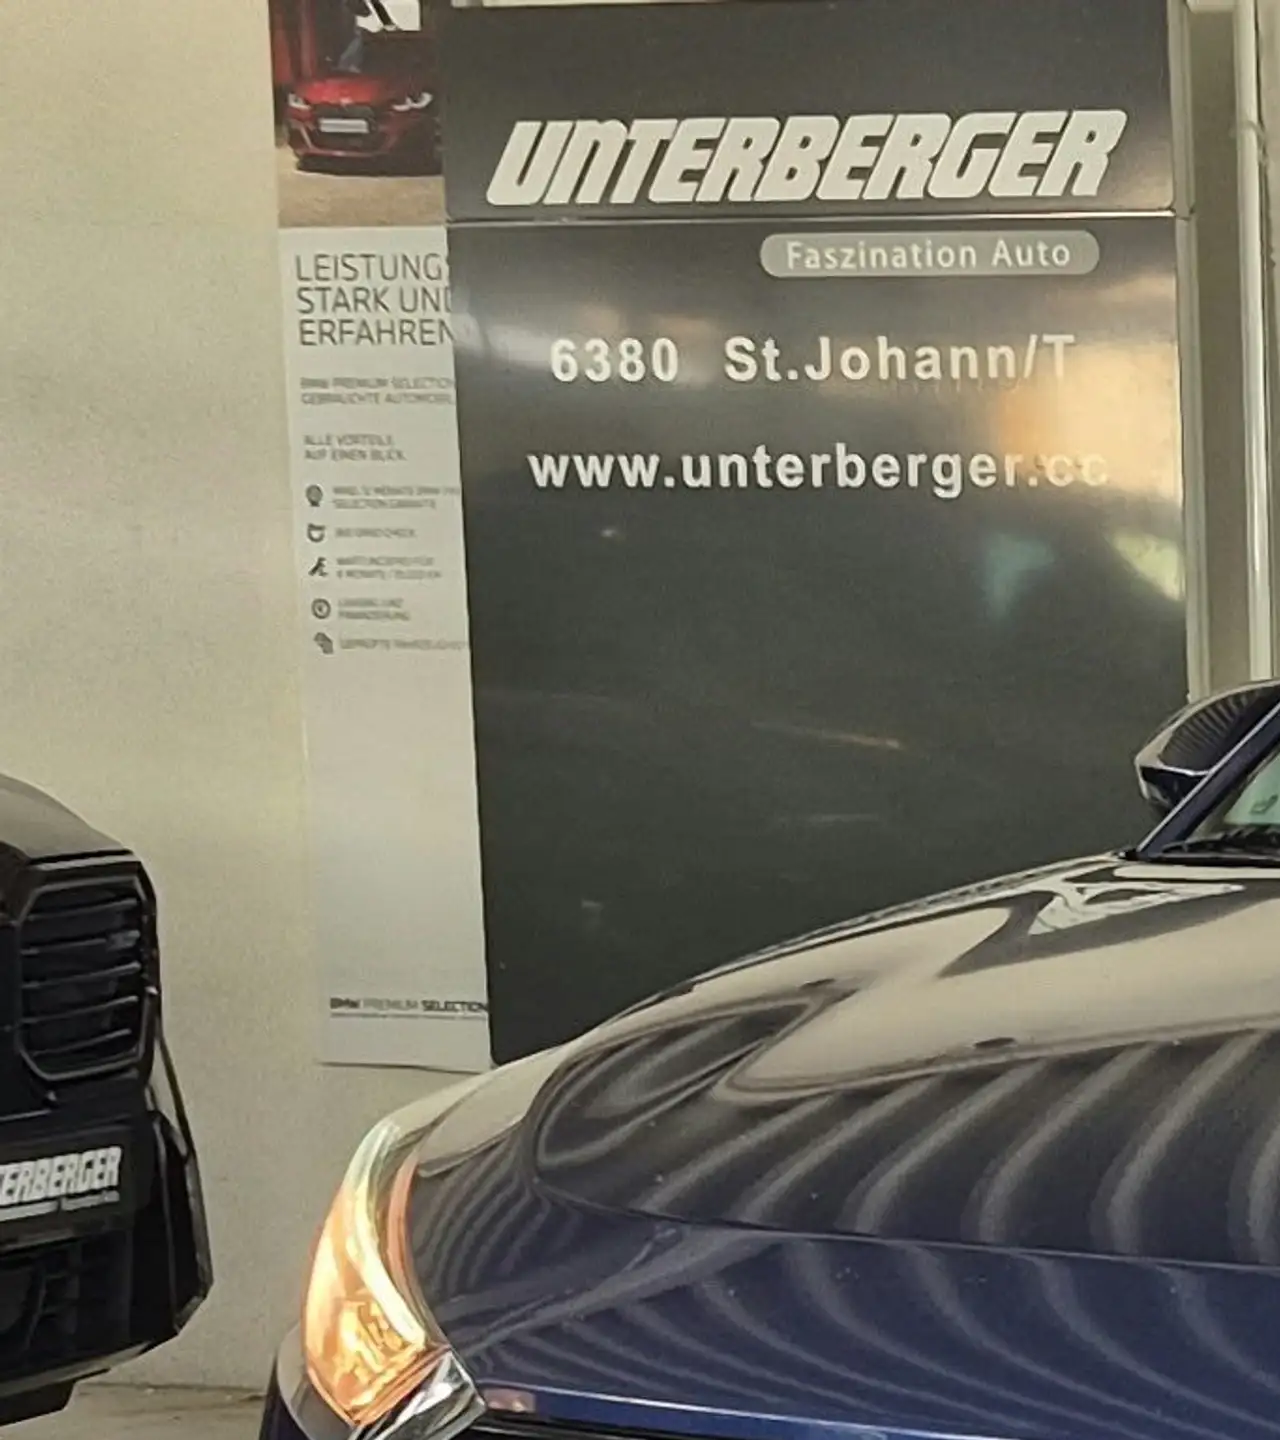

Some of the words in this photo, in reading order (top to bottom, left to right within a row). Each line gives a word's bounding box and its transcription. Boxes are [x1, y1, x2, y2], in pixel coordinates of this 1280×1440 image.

[486, 109, 1128, 205] UNTERBERGER
[295, 252, 446, 282] LEISTUNG
[787, 238, 977, 269] Faszination
[992, 237, 1071, 268] Auto
[297, 286, 390, 315] STARK
[550, 337, 679, 383] 6380
[725, 333, 1075, 382] St.Johann/T
[527, 444, 1108, 498] www.unterberger.cc
[0, 1146, 122, 1206] ERBERGER
